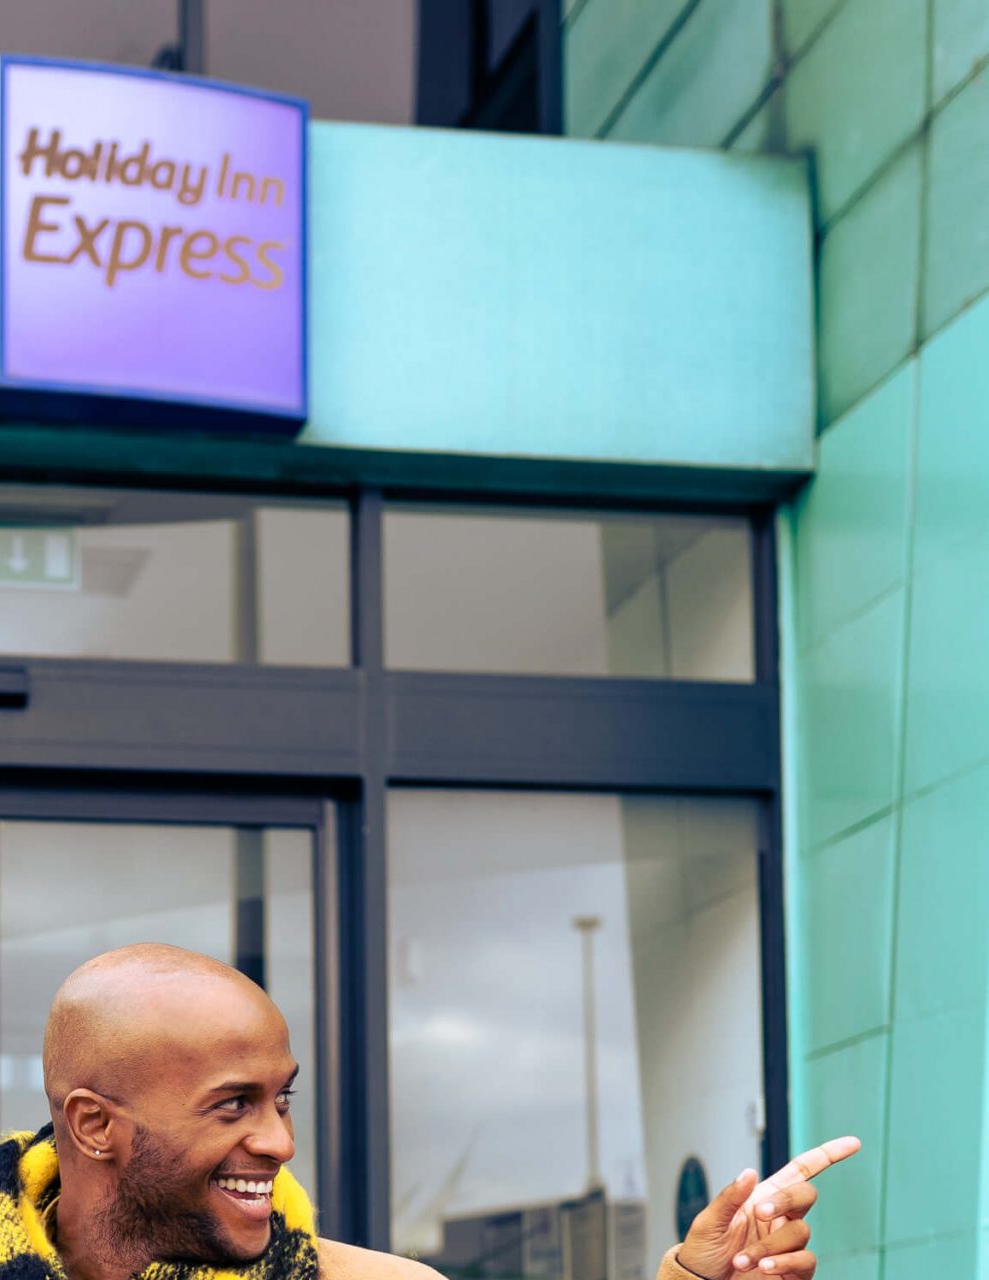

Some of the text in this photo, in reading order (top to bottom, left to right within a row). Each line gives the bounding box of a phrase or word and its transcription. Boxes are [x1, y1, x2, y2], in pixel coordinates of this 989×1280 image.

[20, 128, 285, 207] Holiday Inn
[22, 195, 285, 290] Express
